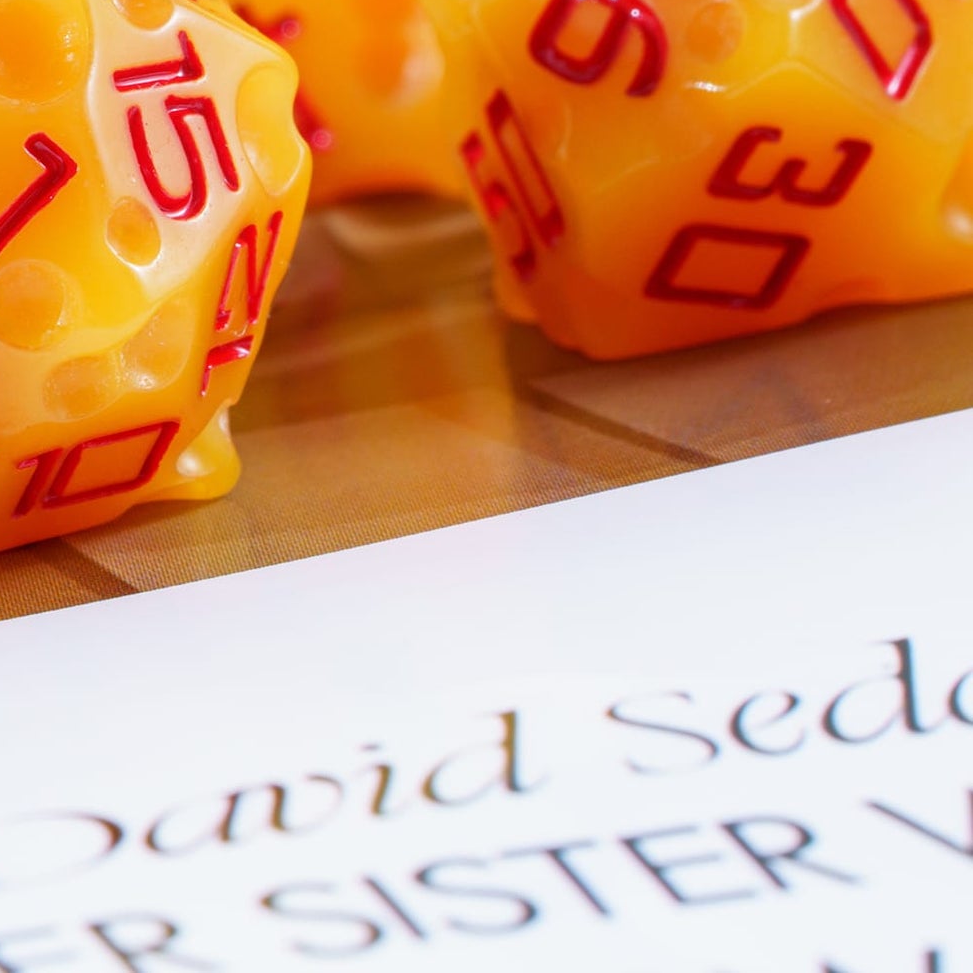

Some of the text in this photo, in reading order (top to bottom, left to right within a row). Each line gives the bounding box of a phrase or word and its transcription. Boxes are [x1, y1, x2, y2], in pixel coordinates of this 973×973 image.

[112, 30, 240, 220] 15
[643, 125, 873, 311] 30
[12, 419, 182, 519] 10
[257, 812, 863, 959] SISTER
